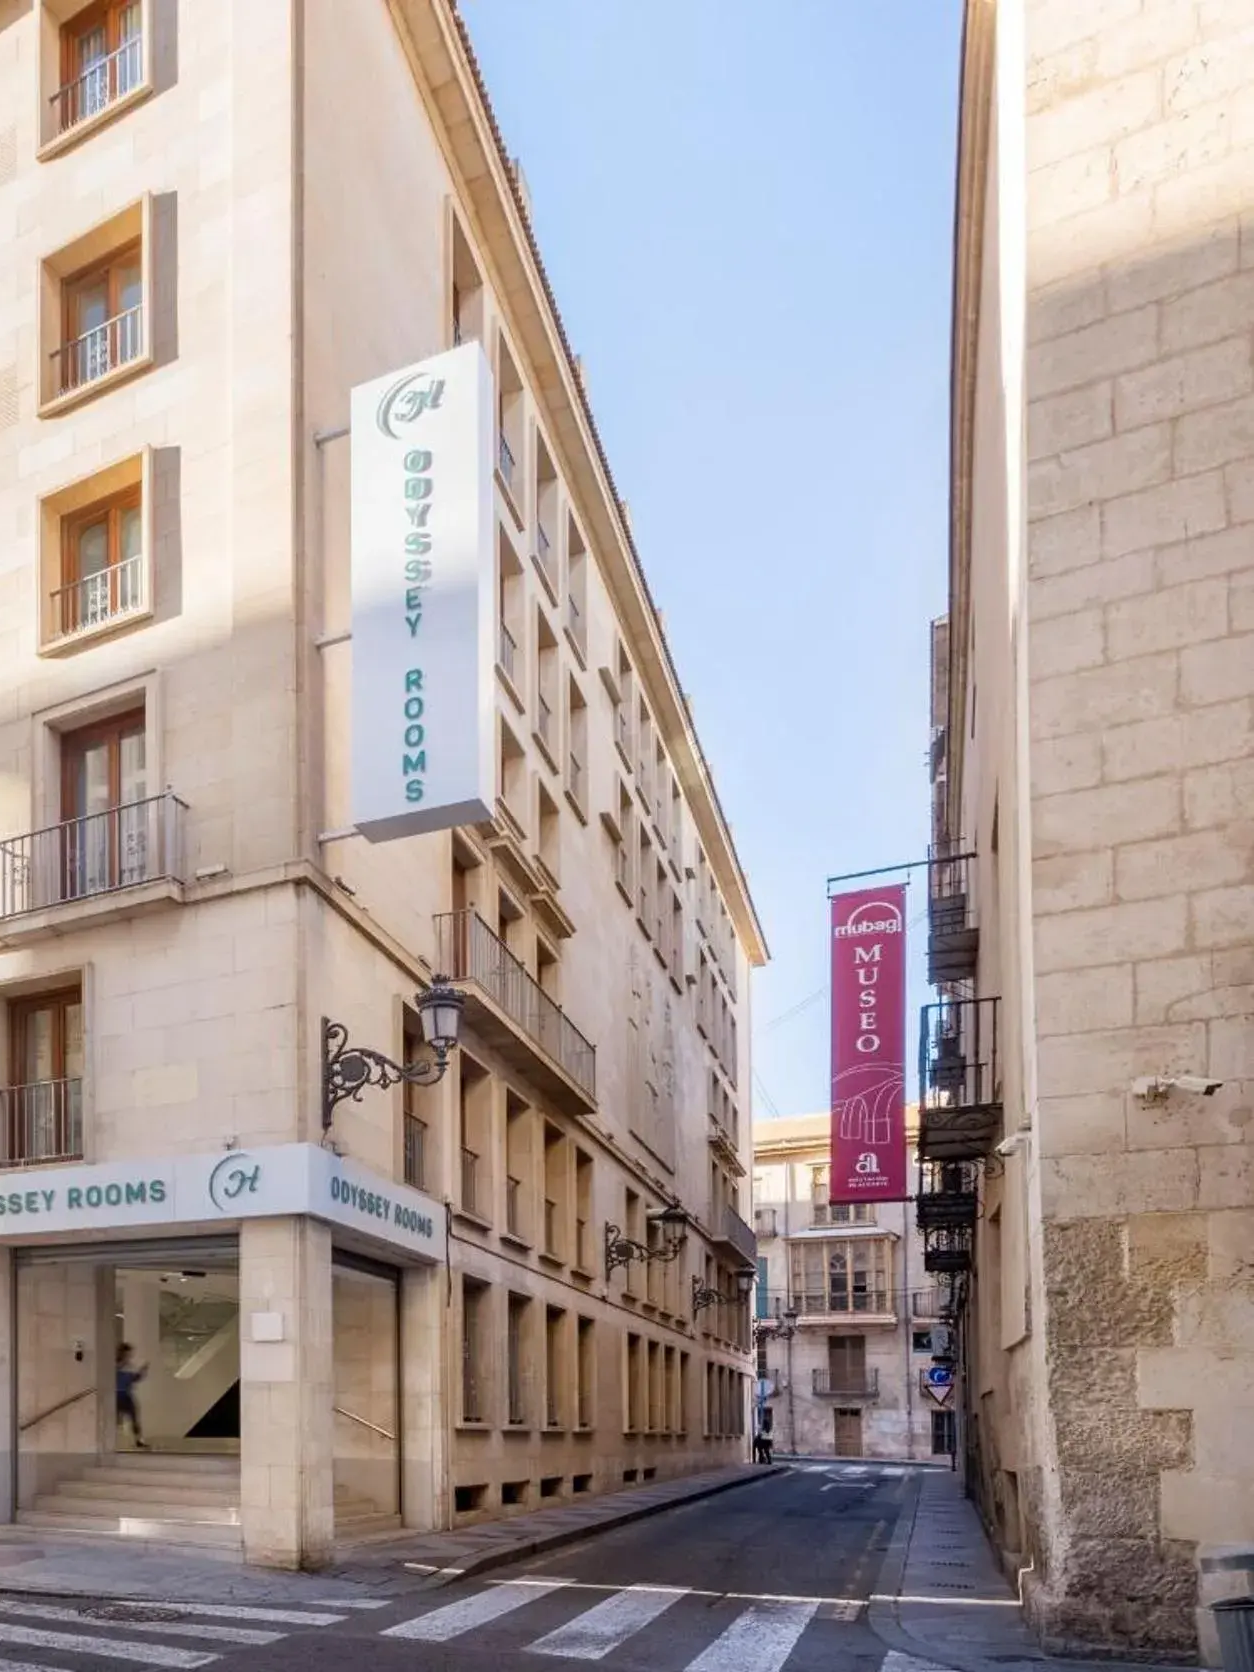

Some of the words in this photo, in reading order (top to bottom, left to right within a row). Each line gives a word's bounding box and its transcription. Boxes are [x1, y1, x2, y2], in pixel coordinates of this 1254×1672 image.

[403, 450, 432, 637] ODYSSEY
[402, 669, 426, 802] ROOMS
[854, 944, 883, 1053] MUSEO
[67, 1179, 166, 1209] ROOMS
[330, 1176, 391, 1222] ODYSSEY
[394, 1203, 434, 1239] ROOMS
